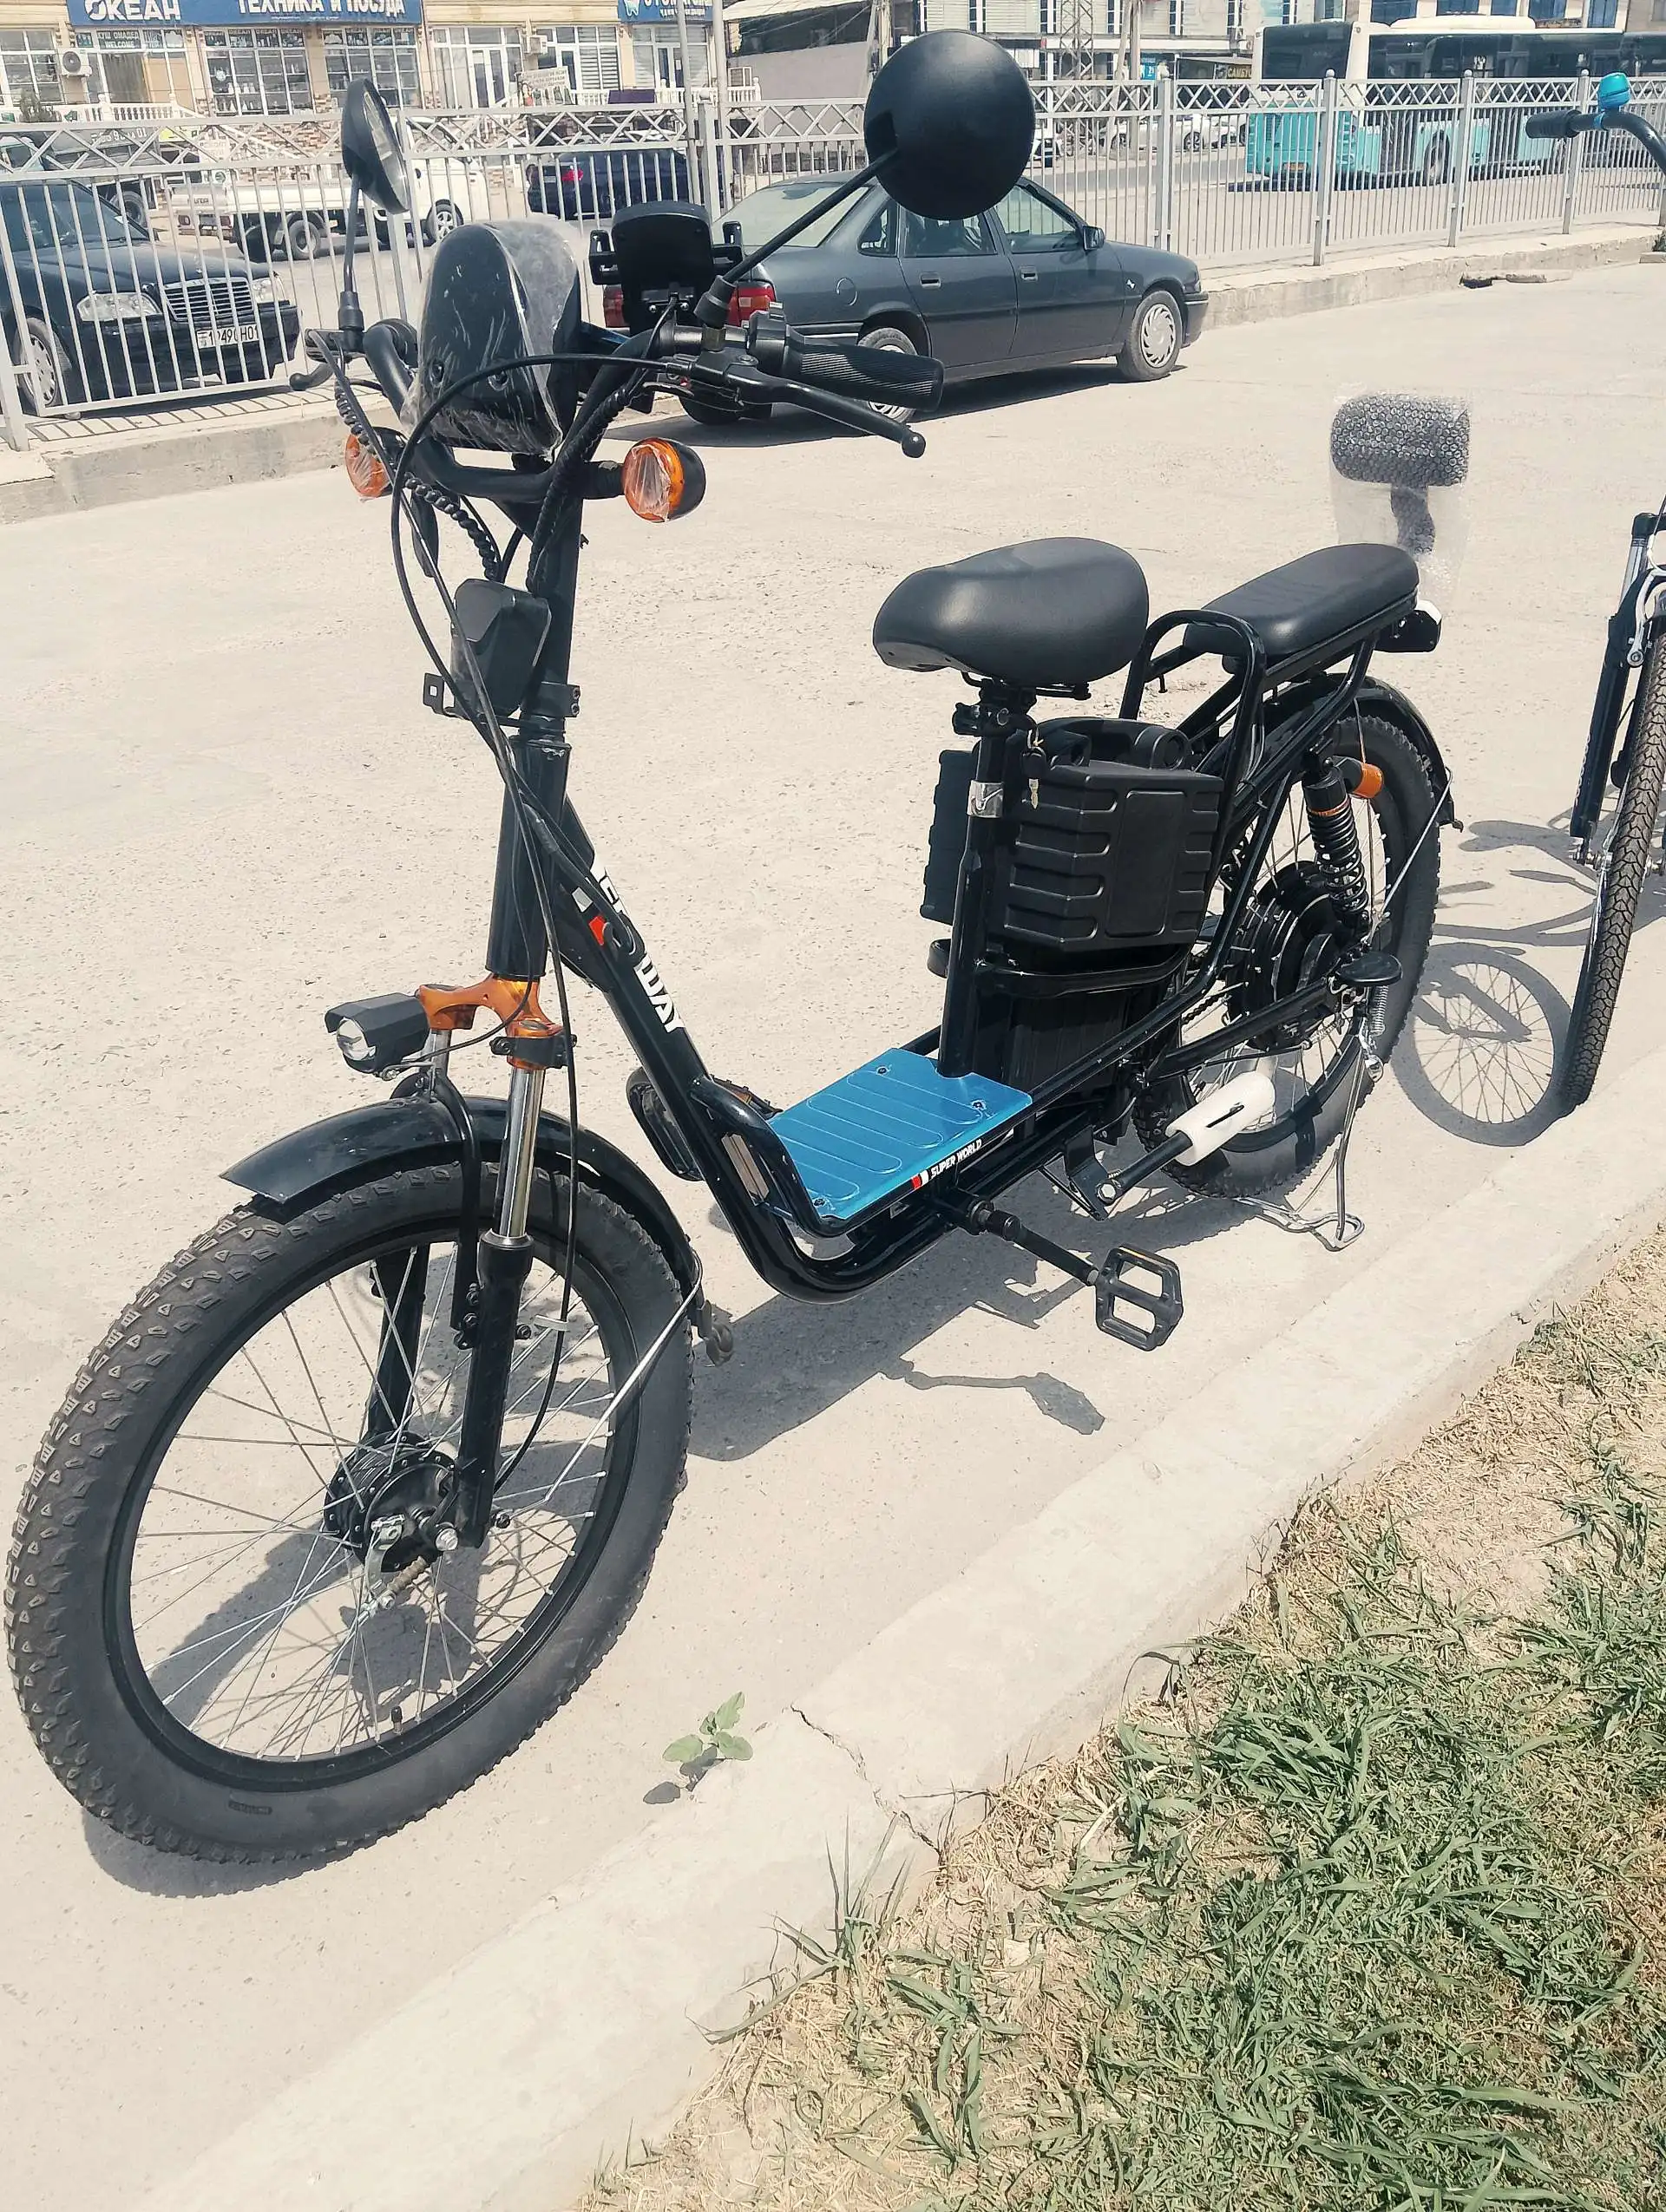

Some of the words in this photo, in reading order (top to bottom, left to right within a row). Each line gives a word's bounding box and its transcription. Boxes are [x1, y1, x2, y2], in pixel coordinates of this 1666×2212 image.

[84, 0, 181, 21] ОКЕАН
[239, 0, 325, 13] ТЕХНИКА
[331, 0, 342, 12] И
[347, 0, 405, 17] ПОСУДА
[931, 1155, 955, 1179] SUPER
[956, 1138, 982, 1163] WORLD
